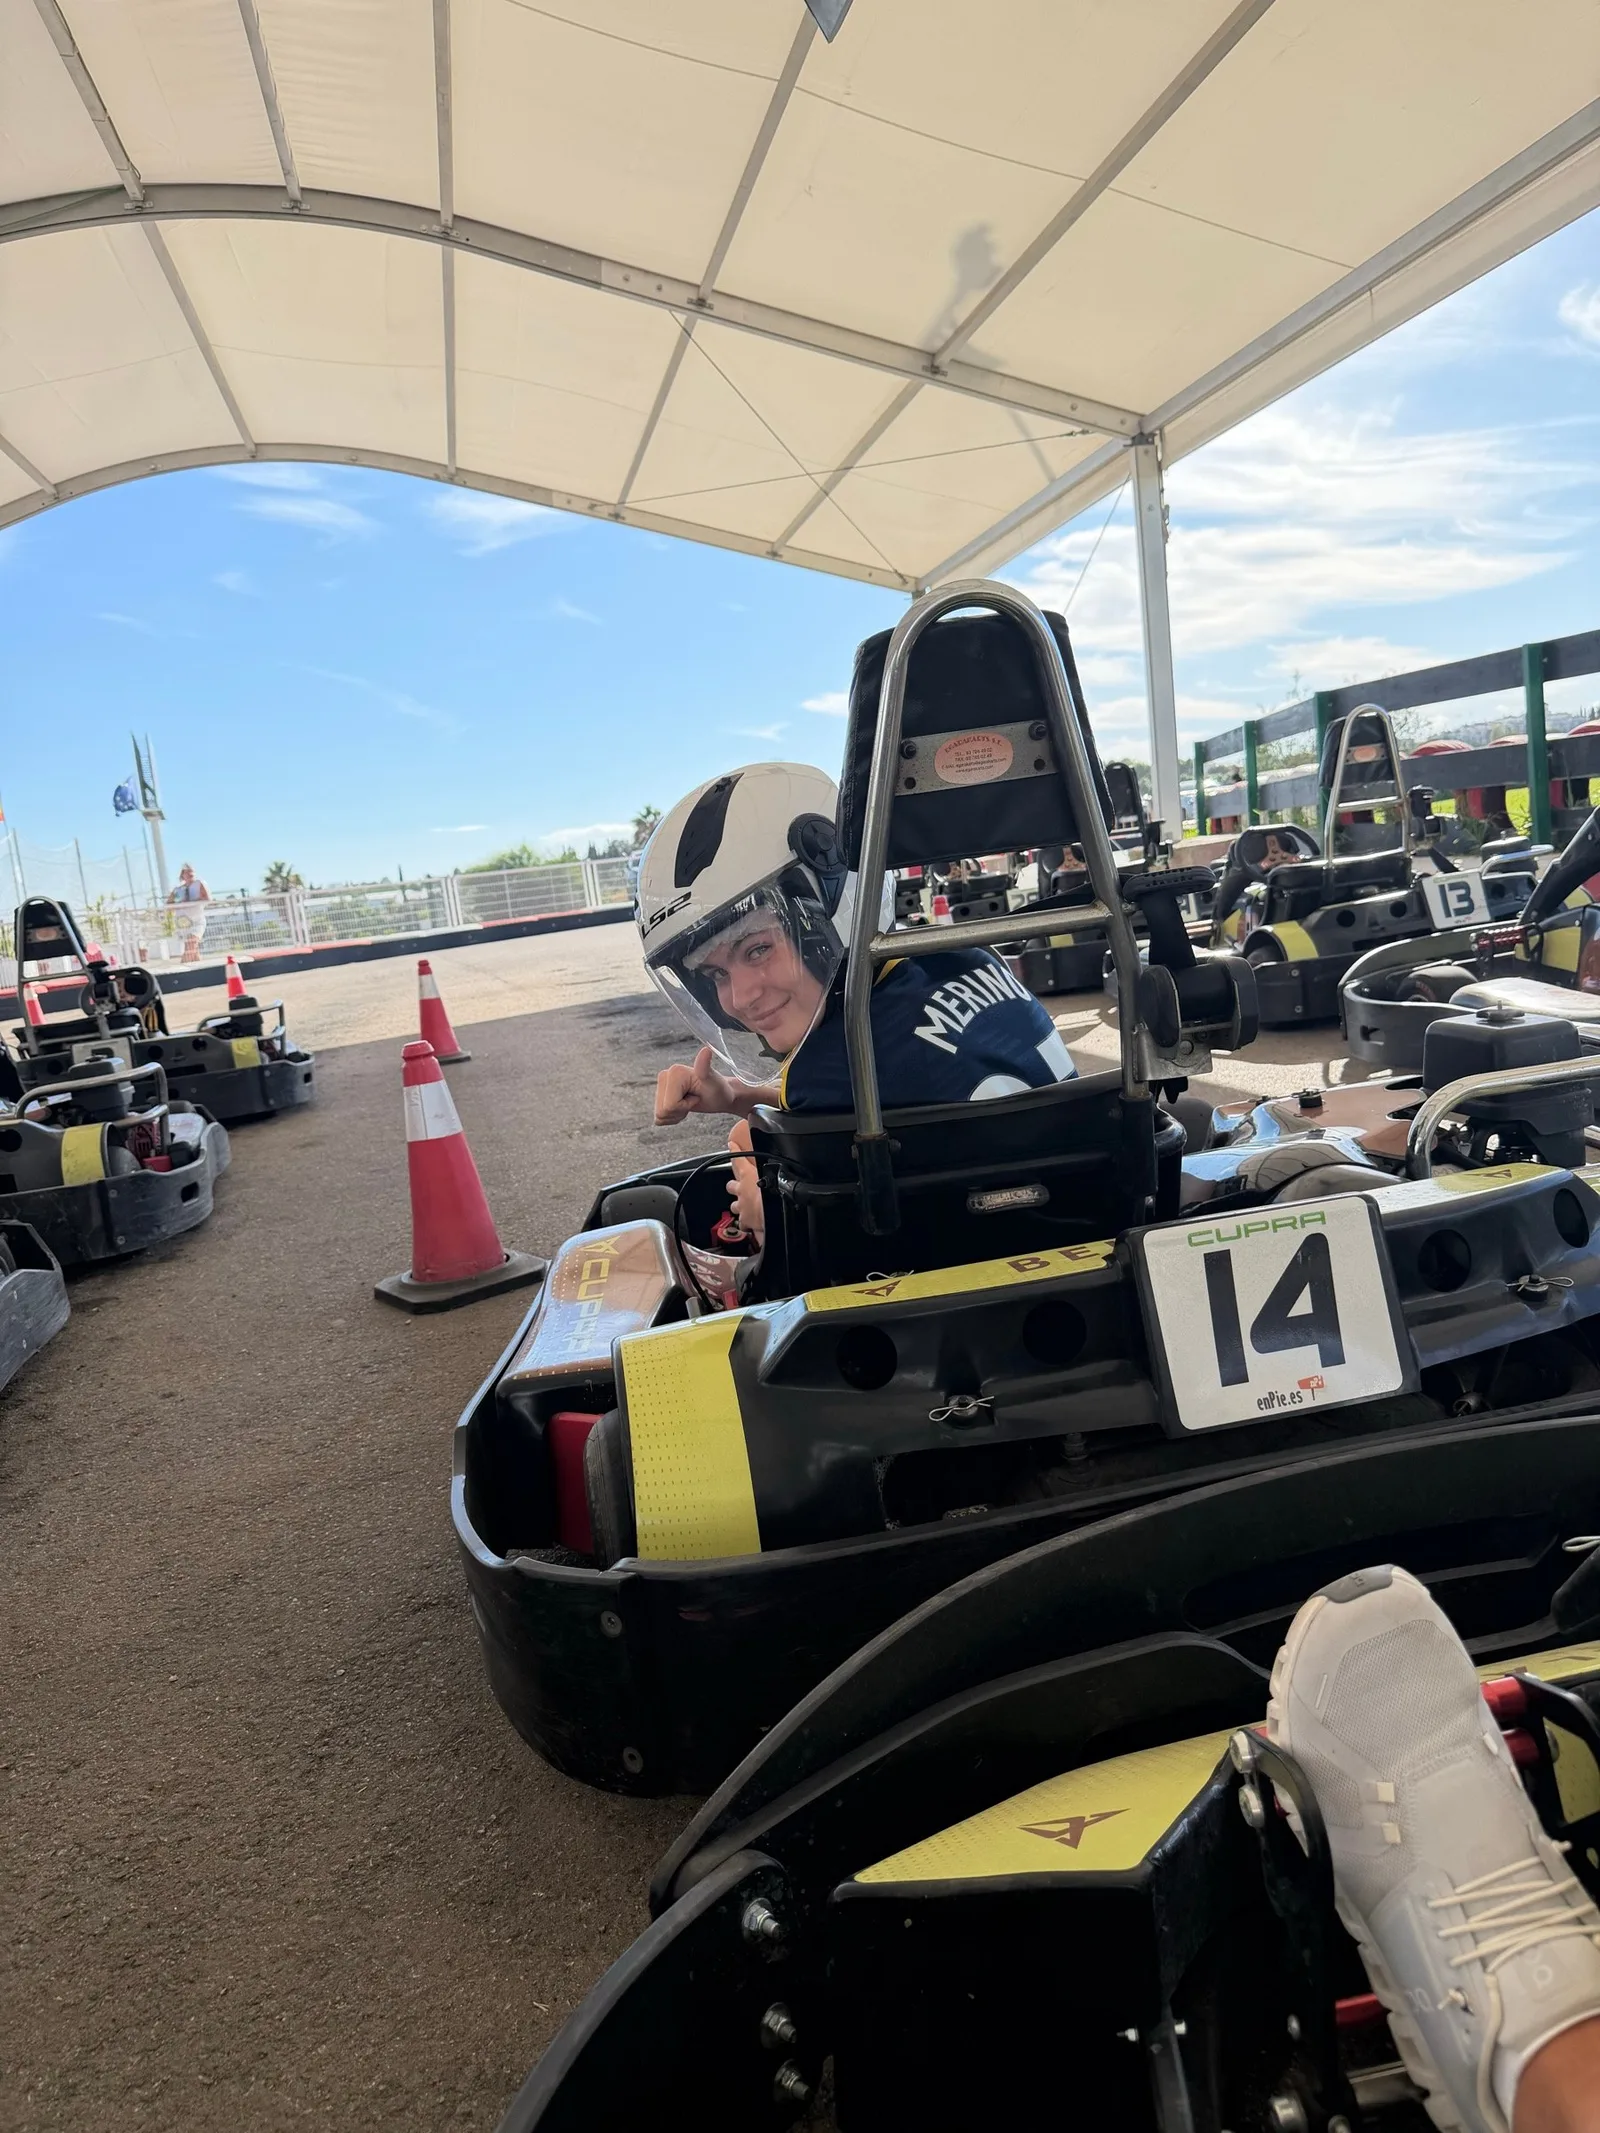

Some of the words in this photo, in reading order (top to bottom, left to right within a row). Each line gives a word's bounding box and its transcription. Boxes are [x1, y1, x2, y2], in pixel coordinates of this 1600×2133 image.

[641, 891, 692, 939] LS2
[1438, 880, 1475, 918] 13
[1187, 1210, 1327, 1248] CUPRA
[1203, 1232, 1346, 1387] 14
[1257, 1390, 1304, 1411] enPie.es
